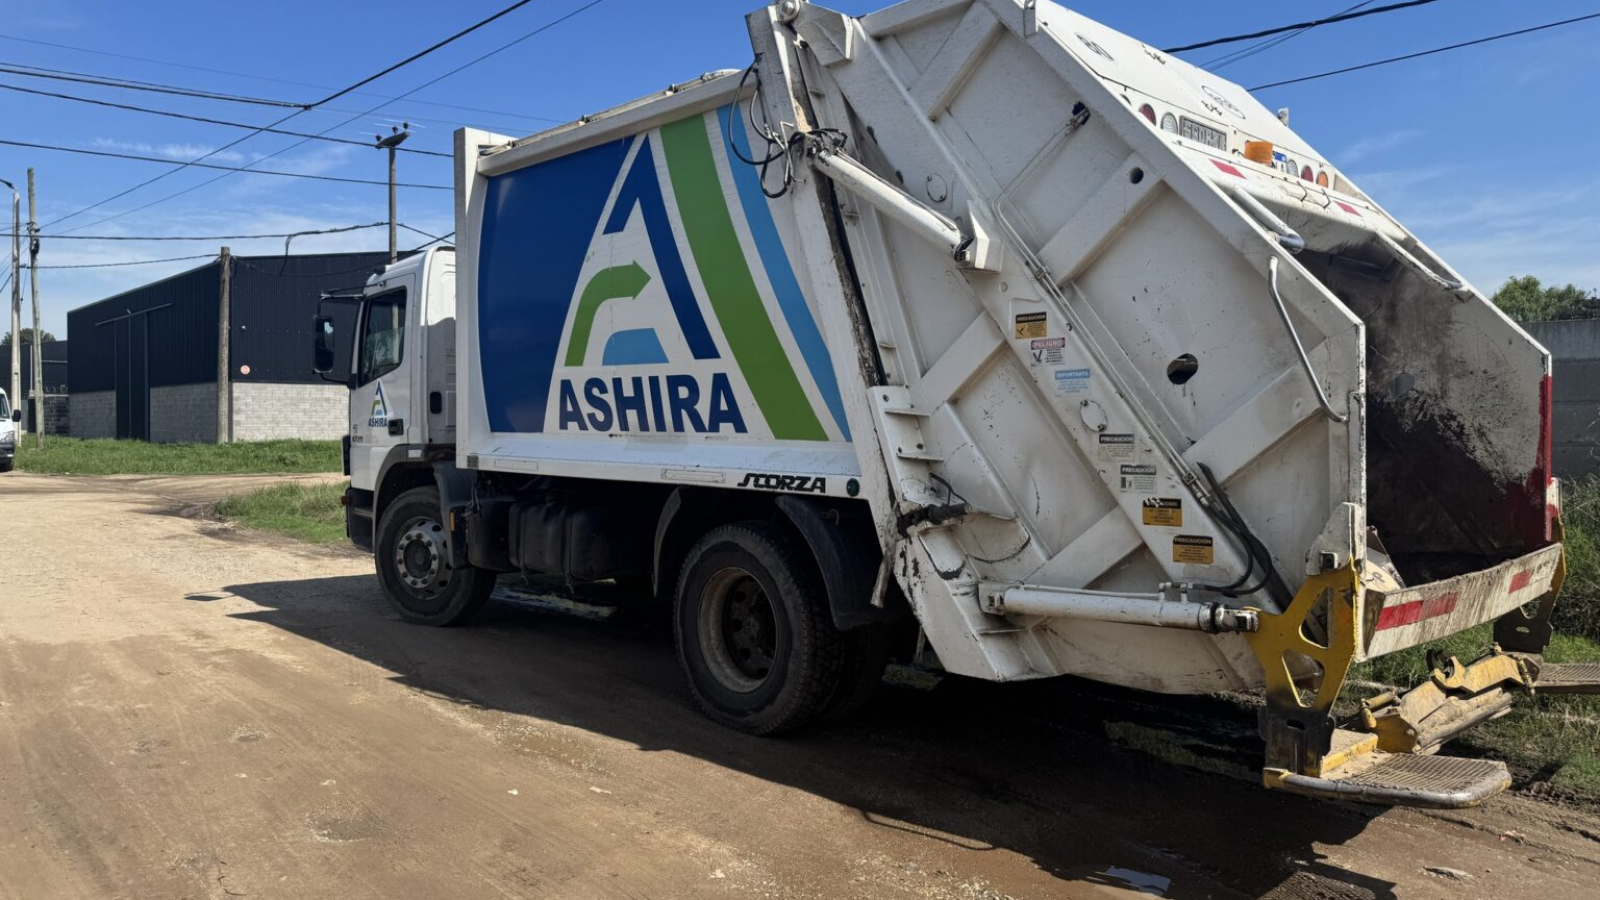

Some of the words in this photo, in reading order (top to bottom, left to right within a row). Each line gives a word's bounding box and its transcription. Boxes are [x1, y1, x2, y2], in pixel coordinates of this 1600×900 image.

[1033, 340, 1062, 348] PELIGRO
[559, 372, 749, 434] ASHIRA
[368, 417, 388, 428] ASHIRA
[737, 472, 826, 494] SCORZA
